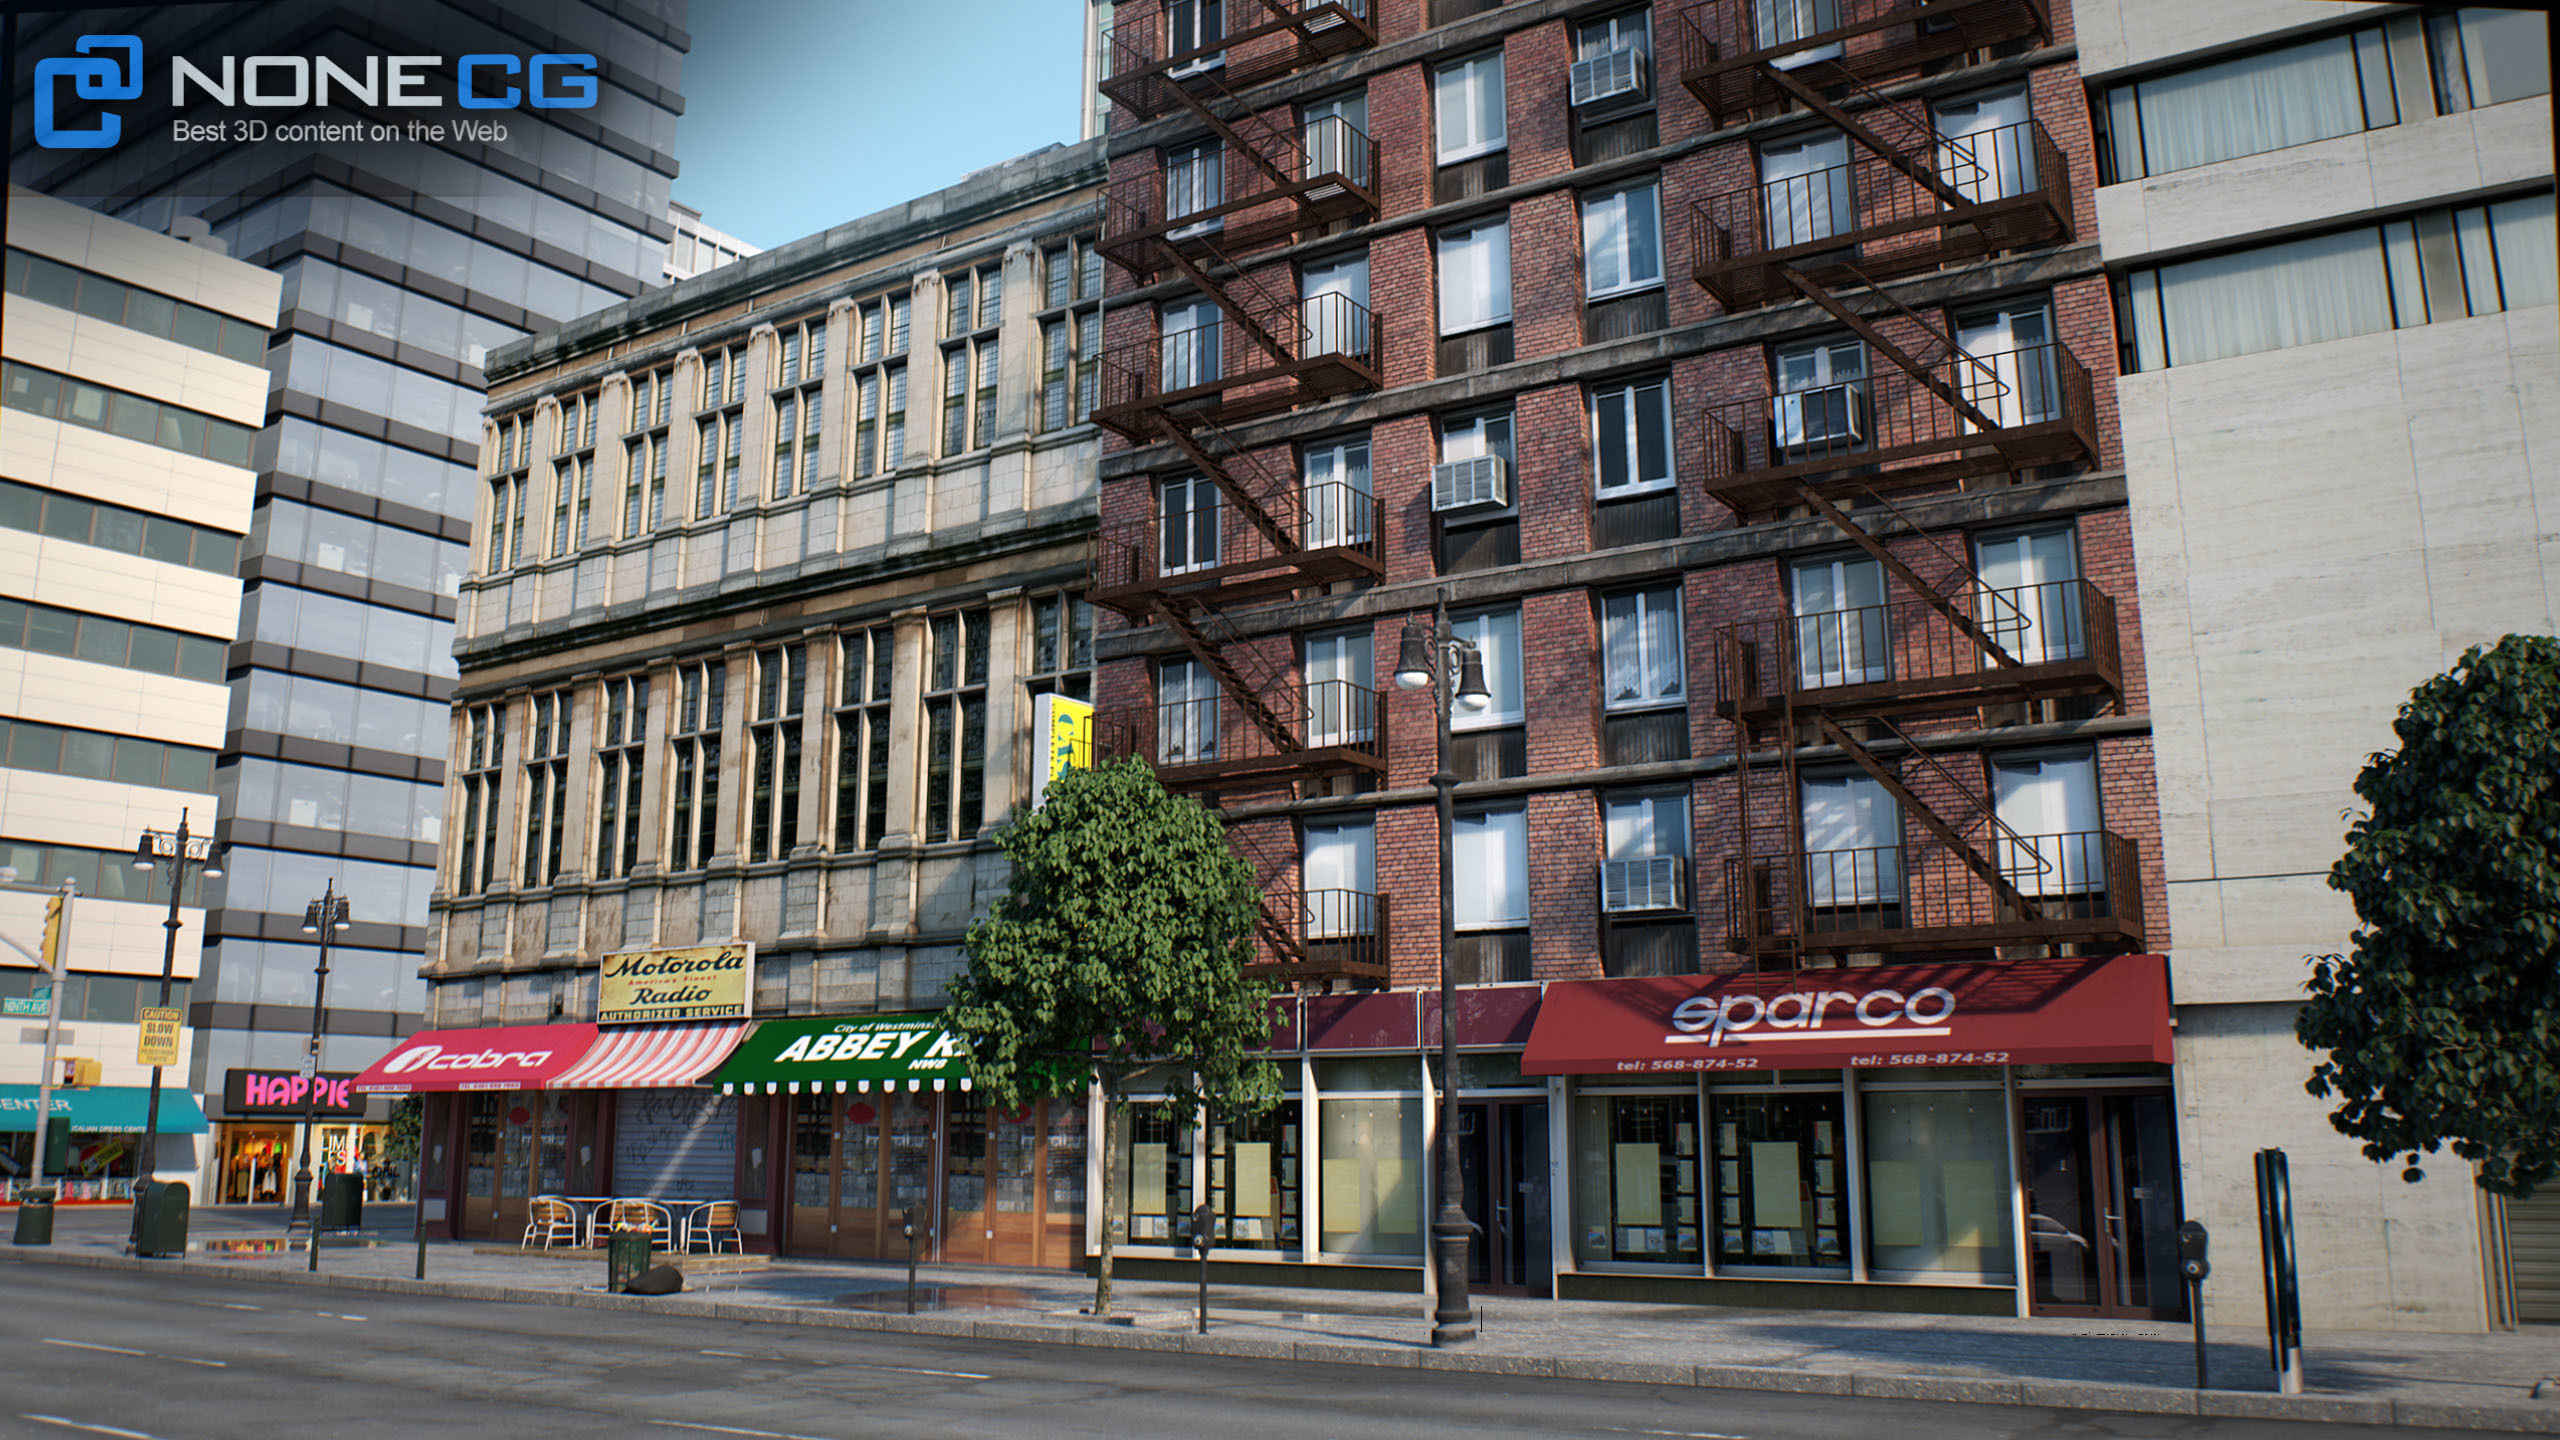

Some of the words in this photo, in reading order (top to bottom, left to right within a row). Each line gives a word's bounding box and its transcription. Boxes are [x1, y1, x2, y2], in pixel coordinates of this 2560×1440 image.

[604, 951, 744, 978] Motorola
[629, 985, 712, 1005] Radio
[600, 1009, 680, 1021] AUTHORIZED
[685, 1005, 743, 1017] SERVICE
[1672, 987, 1956, 1048] sparco
[146, 1023, 174, 1033] SLOW
[834, 1024, 857, 1032] City
[144, 1036, 174, 1047] DOWN
[774, 1031, 930, 1063] ABBEY
[427, 1048, 553, 1070] cobra
[1617, 1060, 1645, 1071] tel:
[1651, 1058, 1758, 1070] 568-874-52
[1850, 1054, 1882, 1066] tel:
[1889, 1051, 2010, 1065] 568-874-52
[0, 1099, 72, 1111] ENTER
